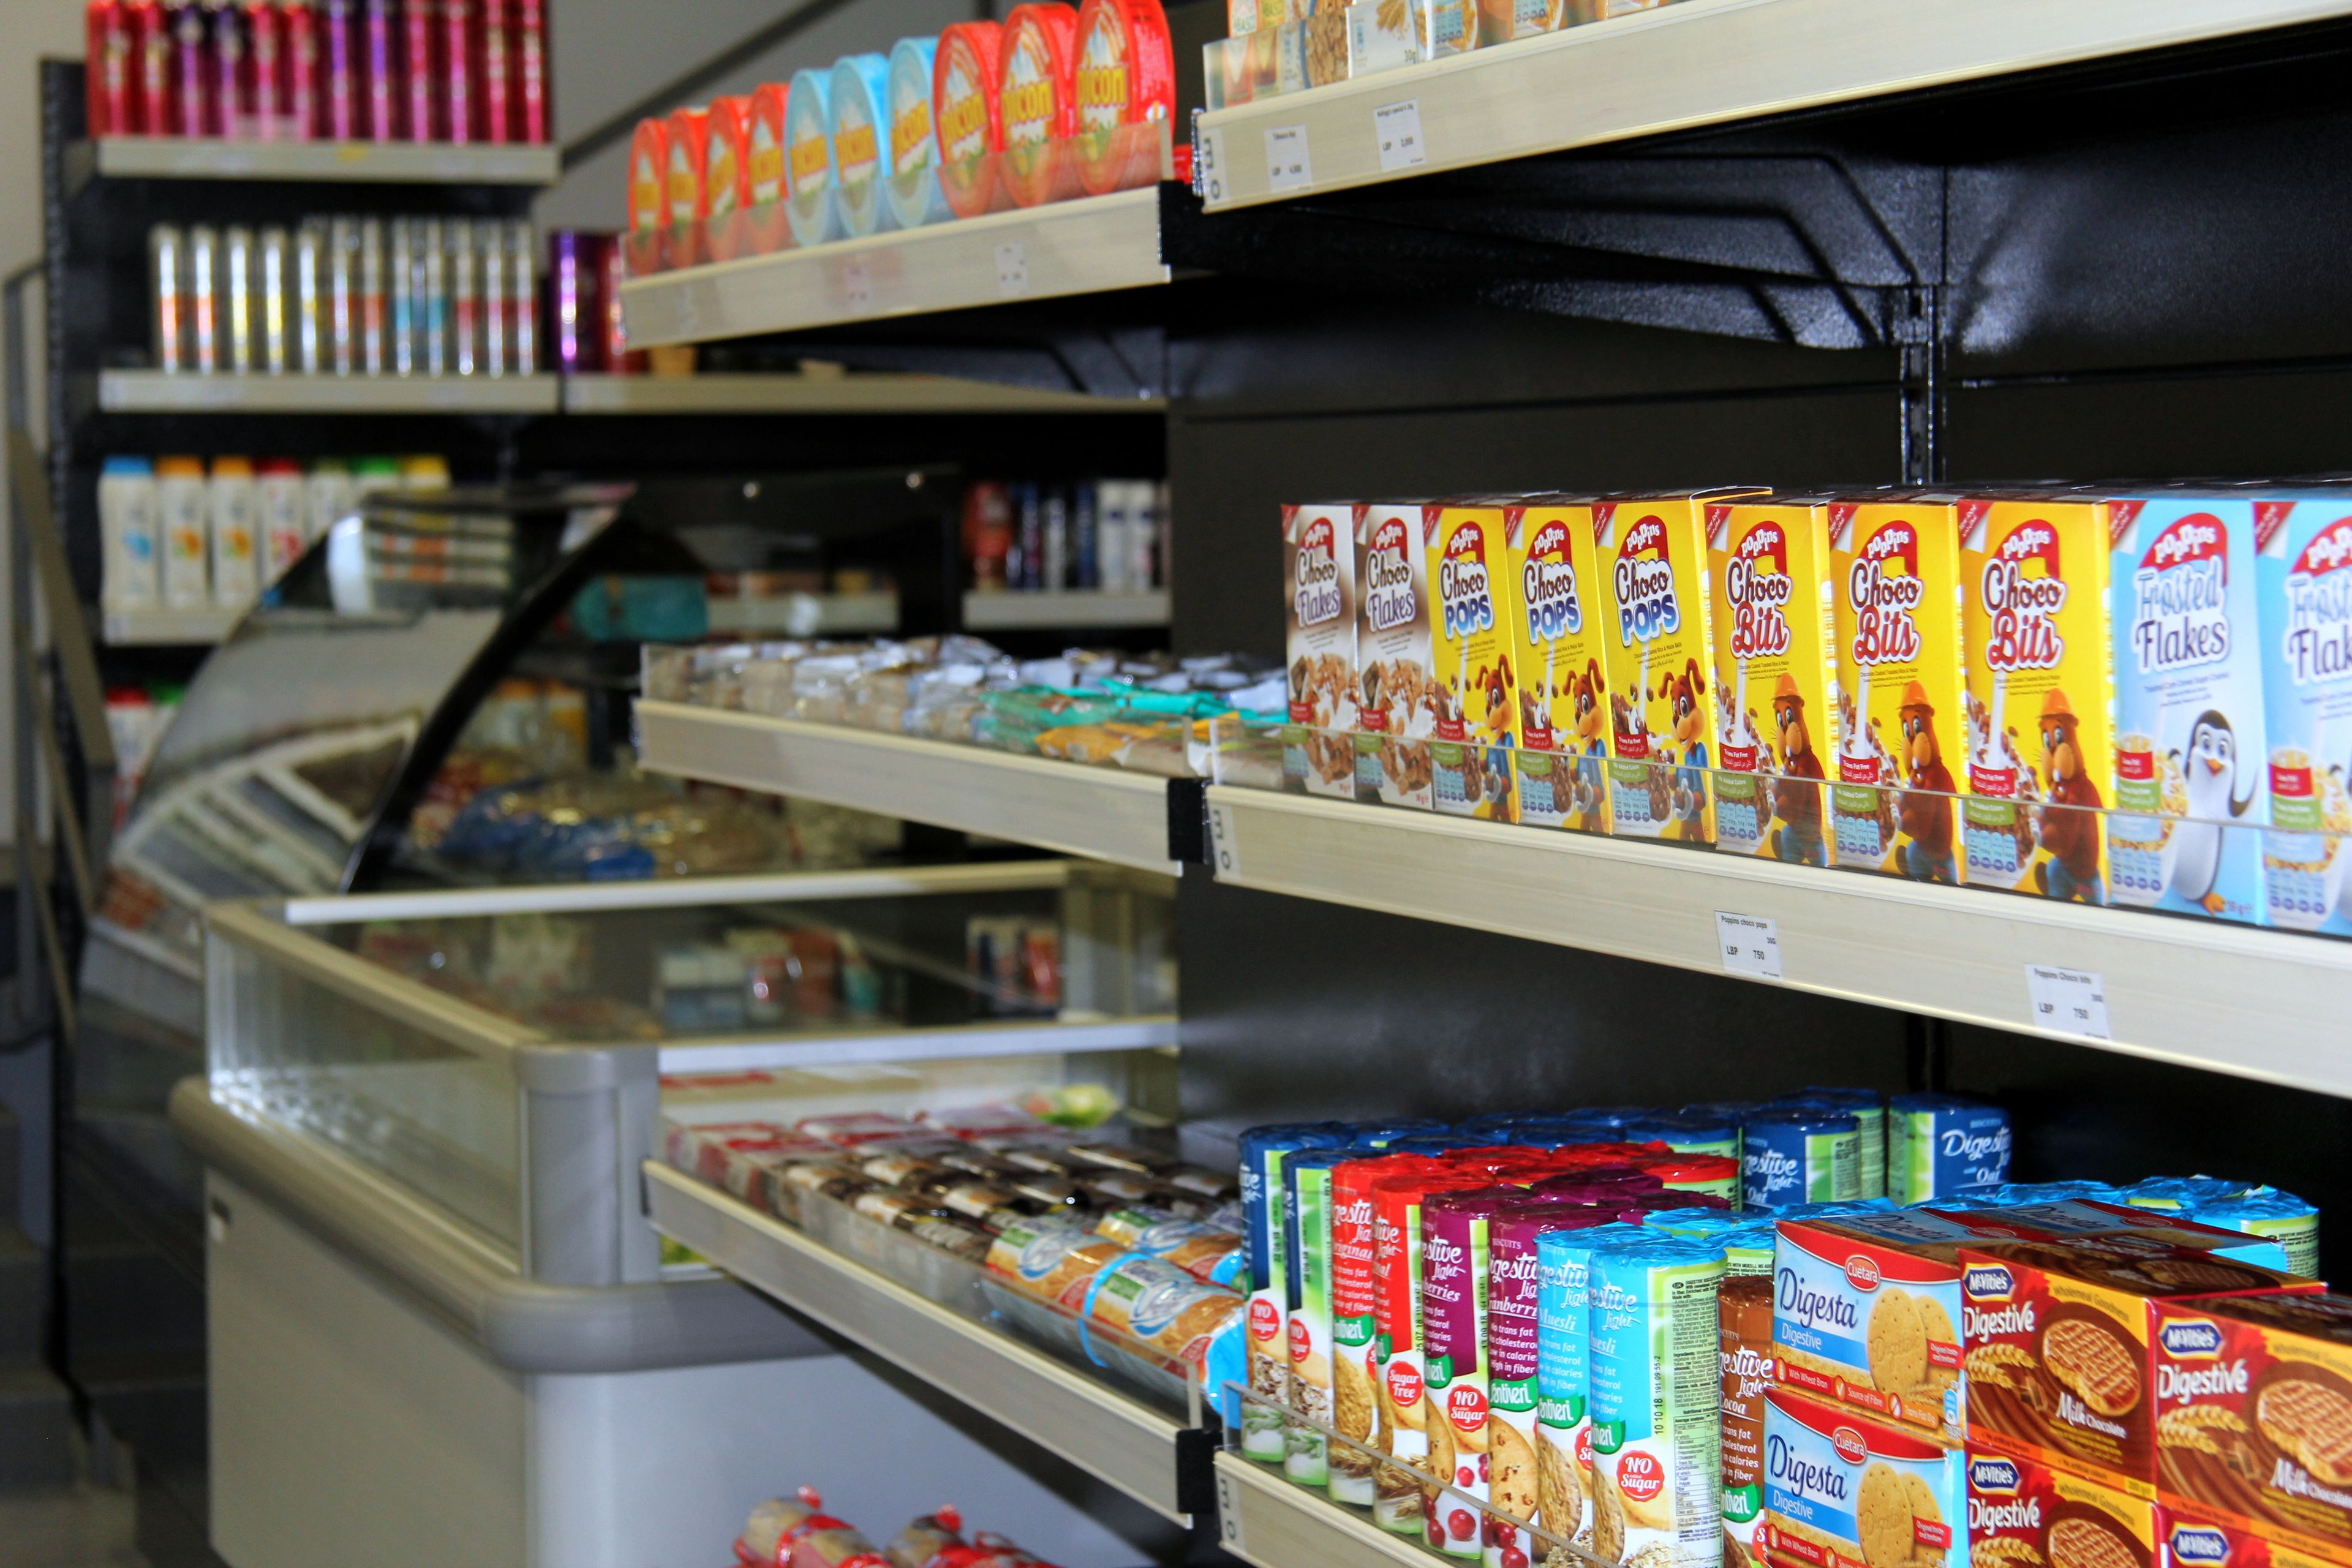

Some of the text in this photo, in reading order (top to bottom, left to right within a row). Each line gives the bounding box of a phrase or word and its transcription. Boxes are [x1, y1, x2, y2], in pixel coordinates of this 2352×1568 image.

[1297, 552, 1335, 586] Choco
[1368, 553, 1409, 589] Choco
[1441, 564, 1485, 601] Choco
[1523, 564, 1572, 605] Choco
[1615, 562, 1670, 605] Choco
[1728, 560, 1789, 604] Choco
[1851, 564, 1920, 608] Choco
[1984, 562, 2061, 611] Choco
[2138, 562, 2220, 620] Frosted
[1298, 587, 1340, 625] Flakes
[1370, 590, 1414, 631] Flakes
[1445, 595, 1490, 638] POPS
[1620, 594, 1677, 641] POPS
[1528, 596, 1580, 641] POPS
[1732, 601, 1788, 654] Bits
[1855, 605, 1919, 660] Bits
[1988, 608, 2059, 666] Bits
[2136, 616, 2226, 668] Flakes
[2289, 625, 2352, 679] Flak
[1721, 916, 1740, 925] Poppins
[1726, 946, 1765, 960] LBP 750
[2038, 1003, 2054, 1013] LBP
[1846, 1262, 1879, 1284] Cuétara
[1778, 1267, 1859, 1329] Digesta
[1499, 1325, 1517, 1335] trans
[1519, 1327, 1533, 1337] fat
[1964, 1300, 2035, 1343] Digestive
[1496, 1336, 1537, 1349] cholestero
[1562, 1342, 1576, 1352] fat
[1782, 1323, 1822, 1351] Digestive
[1389, 1370, 1419, 1385] Sugar
[1505, 1362, 1512, 1371] in
[1513, 1363, 1536, 1374] fiber
[1552, 1366, 1583, 1379] calories
[1604, 1365, 1616, 1377] fat
[1789, 1368, 1828, 1389] With Wheat Bran
[1392, 1382, 1415, 1398] Free
[1557, 1379, 1577, 1390] fiber
[2158, 1358, 2248, 1405] Digestive
[1453, 1391, 1479, 1406] NO
[1654, 1398, 1663, 1409] 18
[1847, 1387, 1864, 1401] Source
[1864, 1392, 1871, 1404] of
[1450, 1407, 1485, 1423] Sugar
[1600, 1404, 1618, 1415] fiber
[1655, 1411, 1664, 1422] 10
[2056, 1391, 2127, 1439] Milk Chocolate
[1656, 1424, 1664, 1436] 10
[1738, 1427, 1752, 1440] fat
[1834, 1434, 1865, 1456] Cuétara
[1625, 1457, 1653, 1474] NO
[1729, 1453, 1759, 1468] calories
[1768, 1434, 1848, 1500] Digesta
[1621, 1474, 1660, 1493] Sugar
[1733, 1466, 1754, 1480] fiber
[1773, 1490, 1813, 1520] Digestive
[1969, 1496, 2040, 1536] Digestive
[1781, 1536, 1819, 1559] With Wheat Bran
